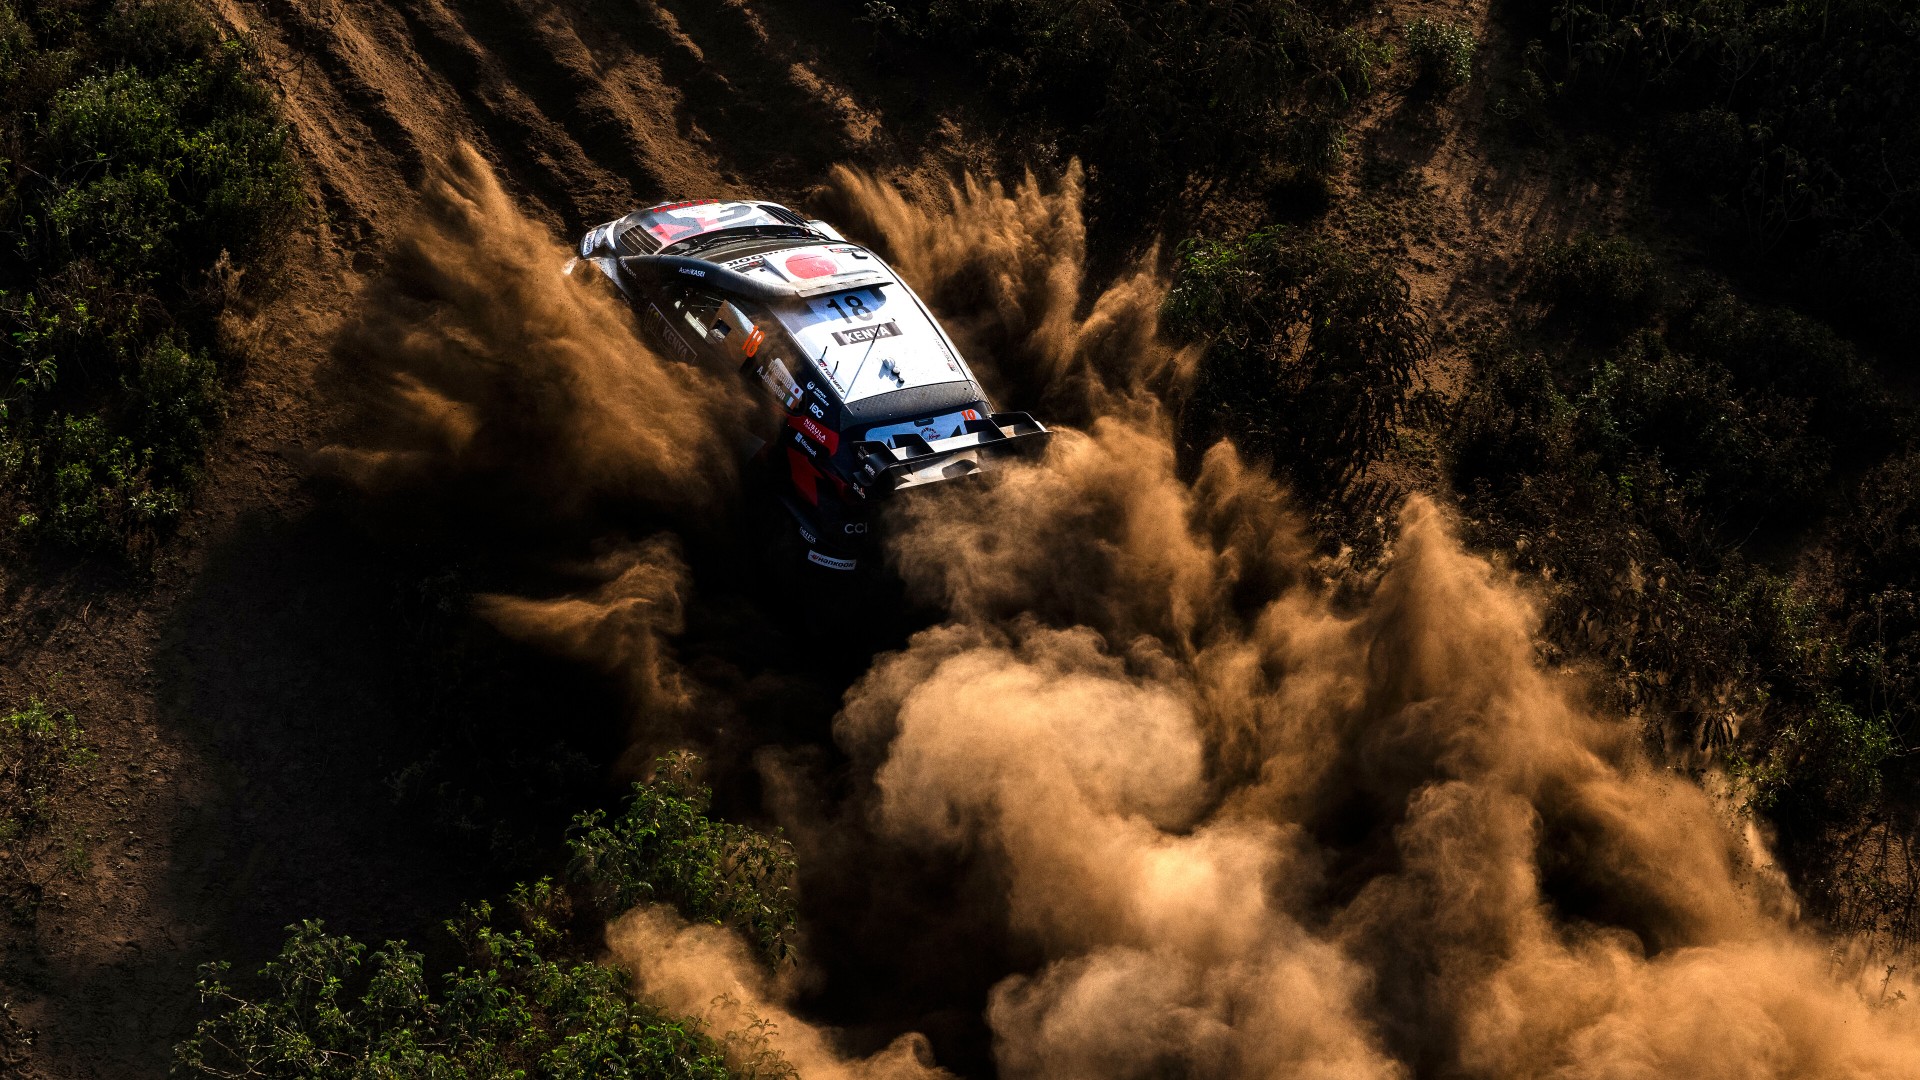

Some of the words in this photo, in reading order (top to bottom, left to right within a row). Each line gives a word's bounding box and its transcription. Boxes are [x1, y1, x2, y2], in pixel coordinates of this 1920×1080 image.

[827, 295, 874, 324] 18
[662, 326, 688, 358] KENYA
[742, 325, 765, 359] 18
[843, 326, 891, 343] KENYA
